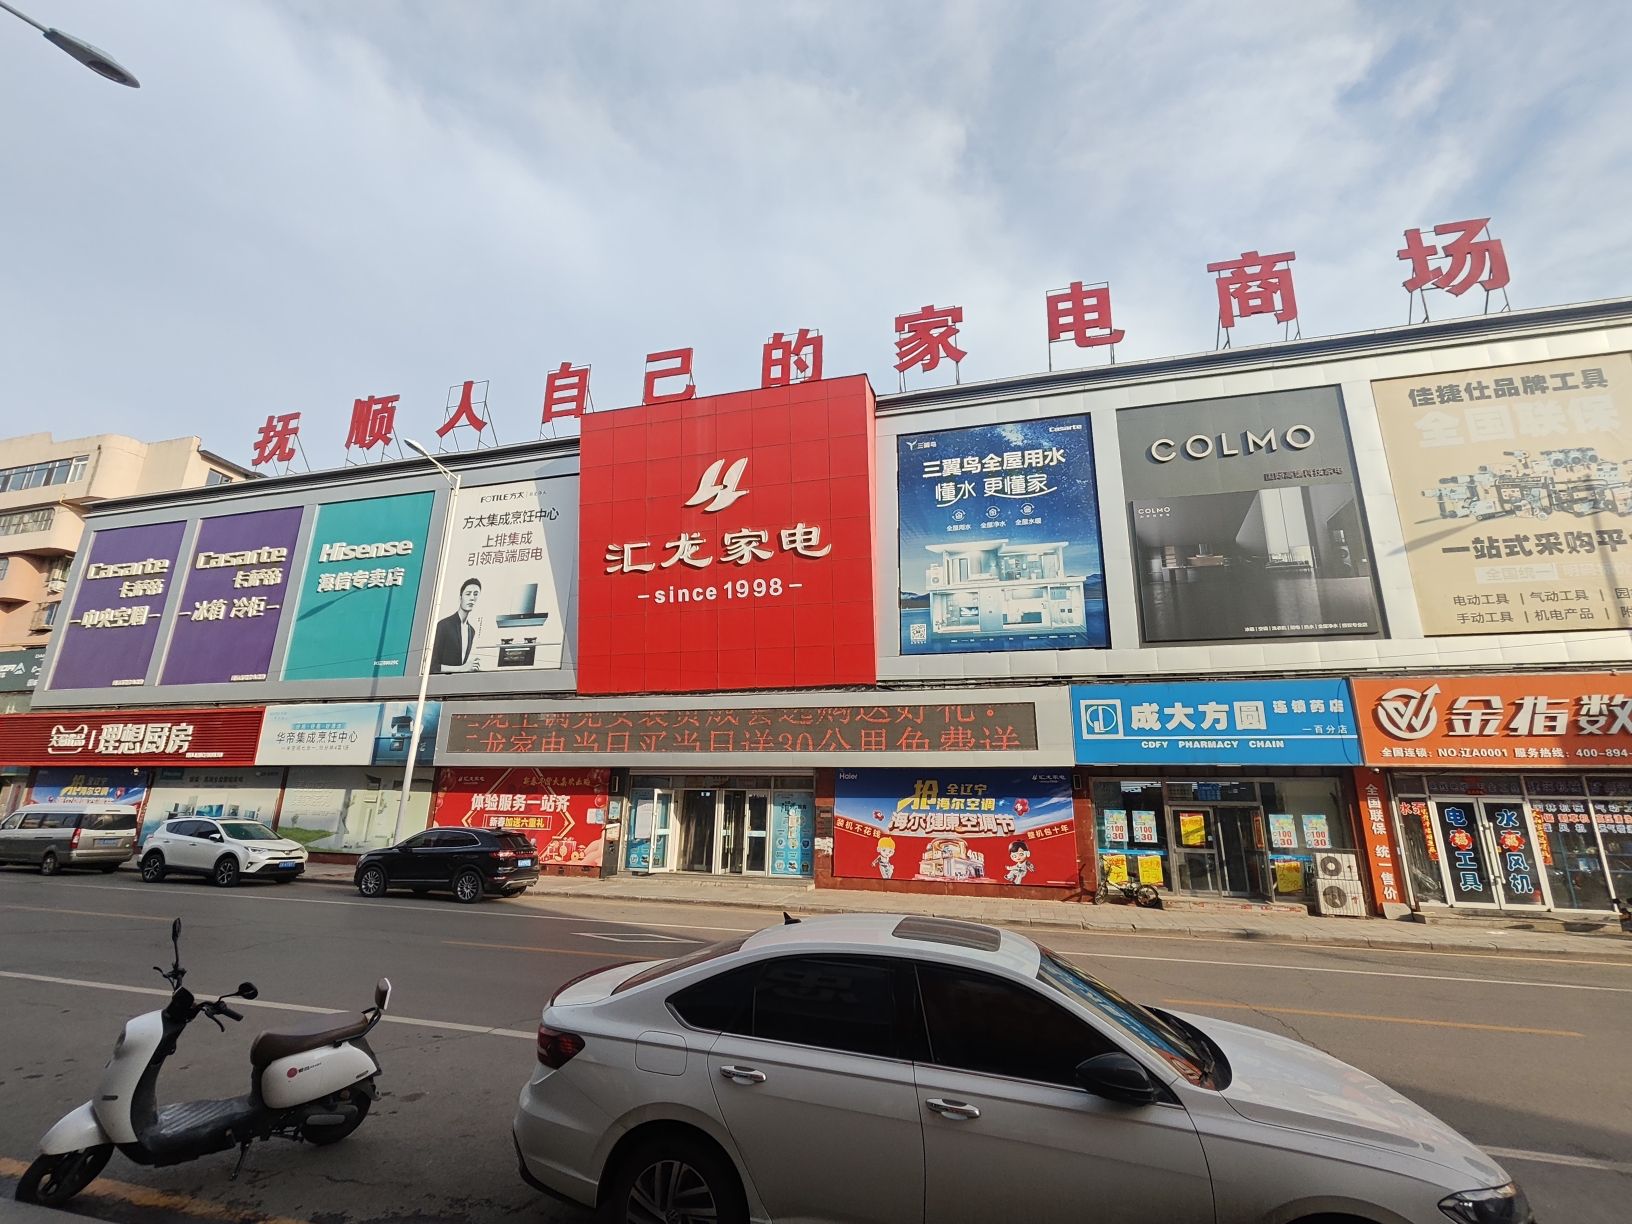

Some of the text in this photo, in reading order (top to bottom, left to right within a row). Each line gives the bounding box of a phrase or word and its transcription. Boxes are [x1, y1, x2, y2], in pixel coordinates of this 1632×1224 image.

[1408, 368, 1608, 407] 佳捷仕品牌工具
[1049, 424, 1082, 433] Casarte
[1414, 395, 1621, 448] 全国联保
[1151, 424, 1315, 462] COLMO
[922, 447, 1065, 478] 三翼鸟全屋用水
[480, 493, 508, 503] FOTILE
[510, 492, 525, 500] 方太
[935, 474, 1050, 504] 懂水 更懂家
[462, 507, 559, 530] 方太集成烹饪中心
[482, 531, 533, 548] 上排集成
[605, 522, 832, 574] 汇龙家电
[1442, 528, 1632, 560] 一站式采购平
[196, 545, 288, 569] Casarte
[319, 539, 413, 564] Hisense
[467, 547, 543, 566] 引领高端厨电
[86, 557, 170, 580] Casarte
[233, 567, 284, 589] 卡萨帝
[317, 567, 404, 593] 海信专卖店
[119, 578, 166, 599] 卡萨帝
[654, 578, 783, 604] since 1998
[1453, 587, 1632, 606] 电动工具 气动工具 园
[80, 605, 150, 629] 中央空调
[191, 597, 268, 621] 冰箱 冷柜
[1457, 611, 1514, 624] 手动工具
[1535, 608, 1594, 621] 机电产品
[1272, 699, 1345, 714] 连锁药店
[1448, 694, 1632, 737] 金指数
[95, 722, 194, 754] 理想厨房
[276, 730, 358, 744] 华帝集成烹饪中心
[1141, 739, 1285, 748] CDFY PHARMACY CHAIN
[839, 771, 858, 780] Haier
[946, 783, 988, 796] 全辽宁
[471, 794, 571, 813] 体验服务一站齐
[936, 797, 996, 811] 海尔空调
[836, 818, 882, 839] 装机不花钱
[888, 811, 1016, 835] 海尔健康空调节
[1027, 824, 1070, 840] 整机包十年
[1365, 784, 1398, 900] 全国联保 统一售价
[1444, 807, 1482, 891] 电工具
[1495, 809, 1534, 893] 水风机
